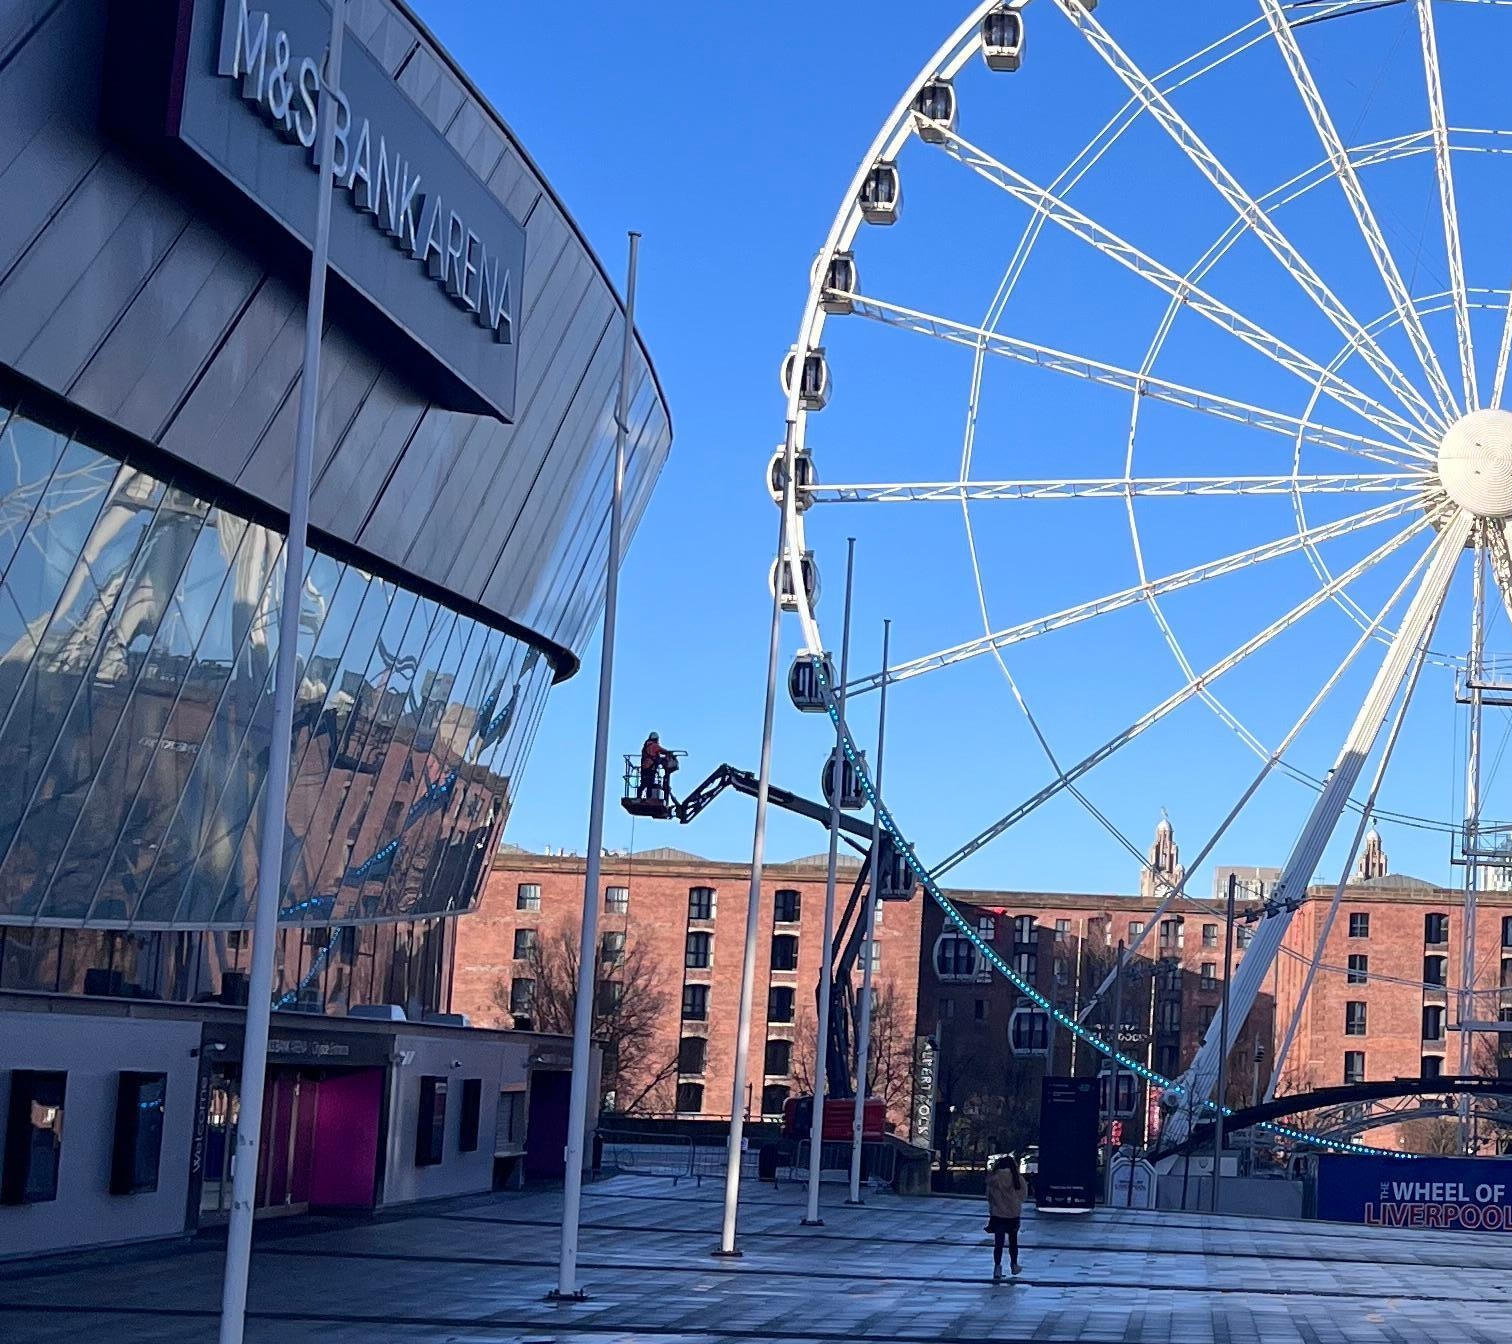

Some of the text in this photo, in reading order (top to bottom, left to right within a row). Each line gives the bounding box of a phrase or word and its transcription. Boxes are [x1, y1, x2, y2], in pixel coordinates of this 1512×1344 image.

[326, 88, 421, 256] BANK
[424, 195, 512, 344] ARENA
[1380, 1181, 1506, 1203] THE WHEEL OF
